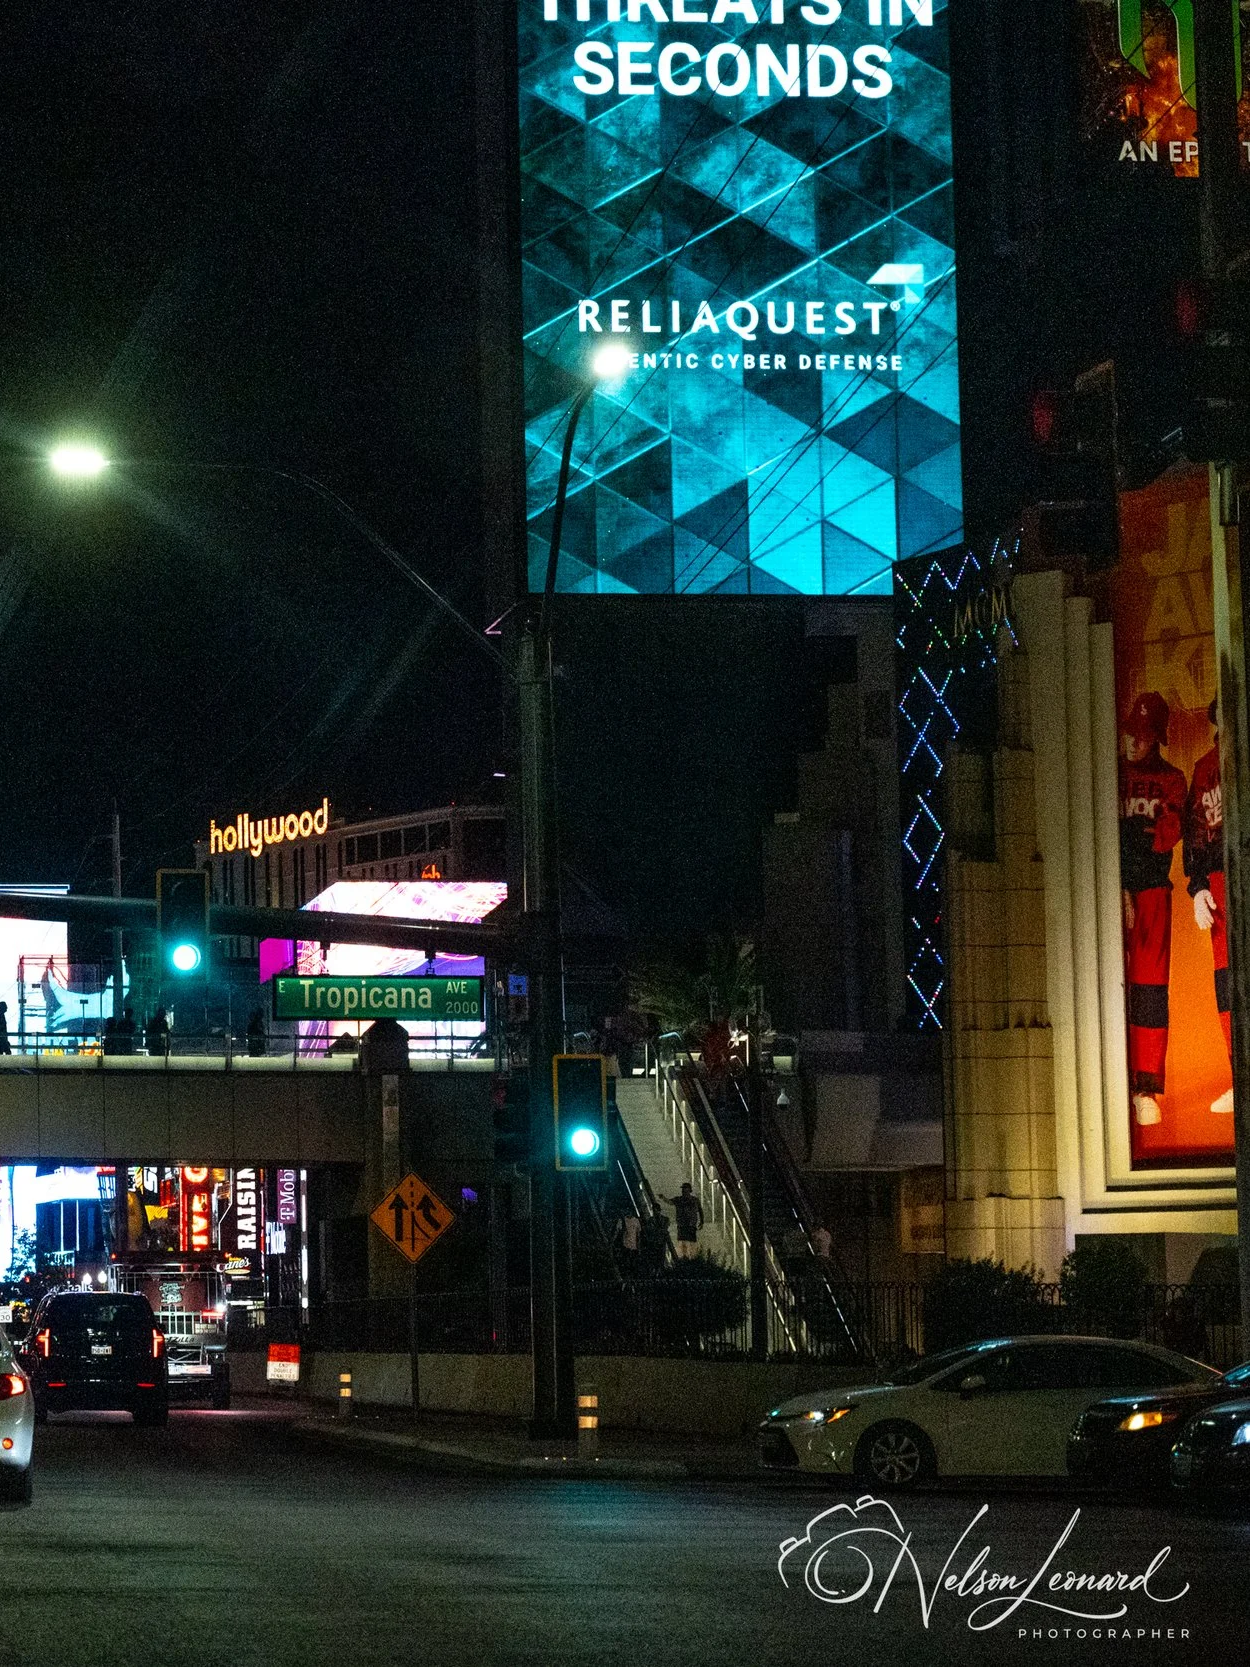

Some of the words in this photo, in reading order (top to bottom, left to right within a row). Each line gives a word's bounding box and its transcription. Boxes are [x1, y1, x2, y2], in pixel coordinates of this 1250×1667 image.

[573, 42, 893, 98] SECONDS
[1118, 140, 1158, 162] AN
[1169, 141, 1199, 162] EP
[629, 353, 699, 369] ENTIC
[711, 353, 787, 370] CYBER
[799, 354, 903, 371] DEFENSE
[210, 797, 329, 857] hollywood
[278, 981, 285, 993] E
[299, 979, 432, 1016] Tropicana
[445, 981, 468, 994] AVE
[446, 1001, 478, 1014] 2000
